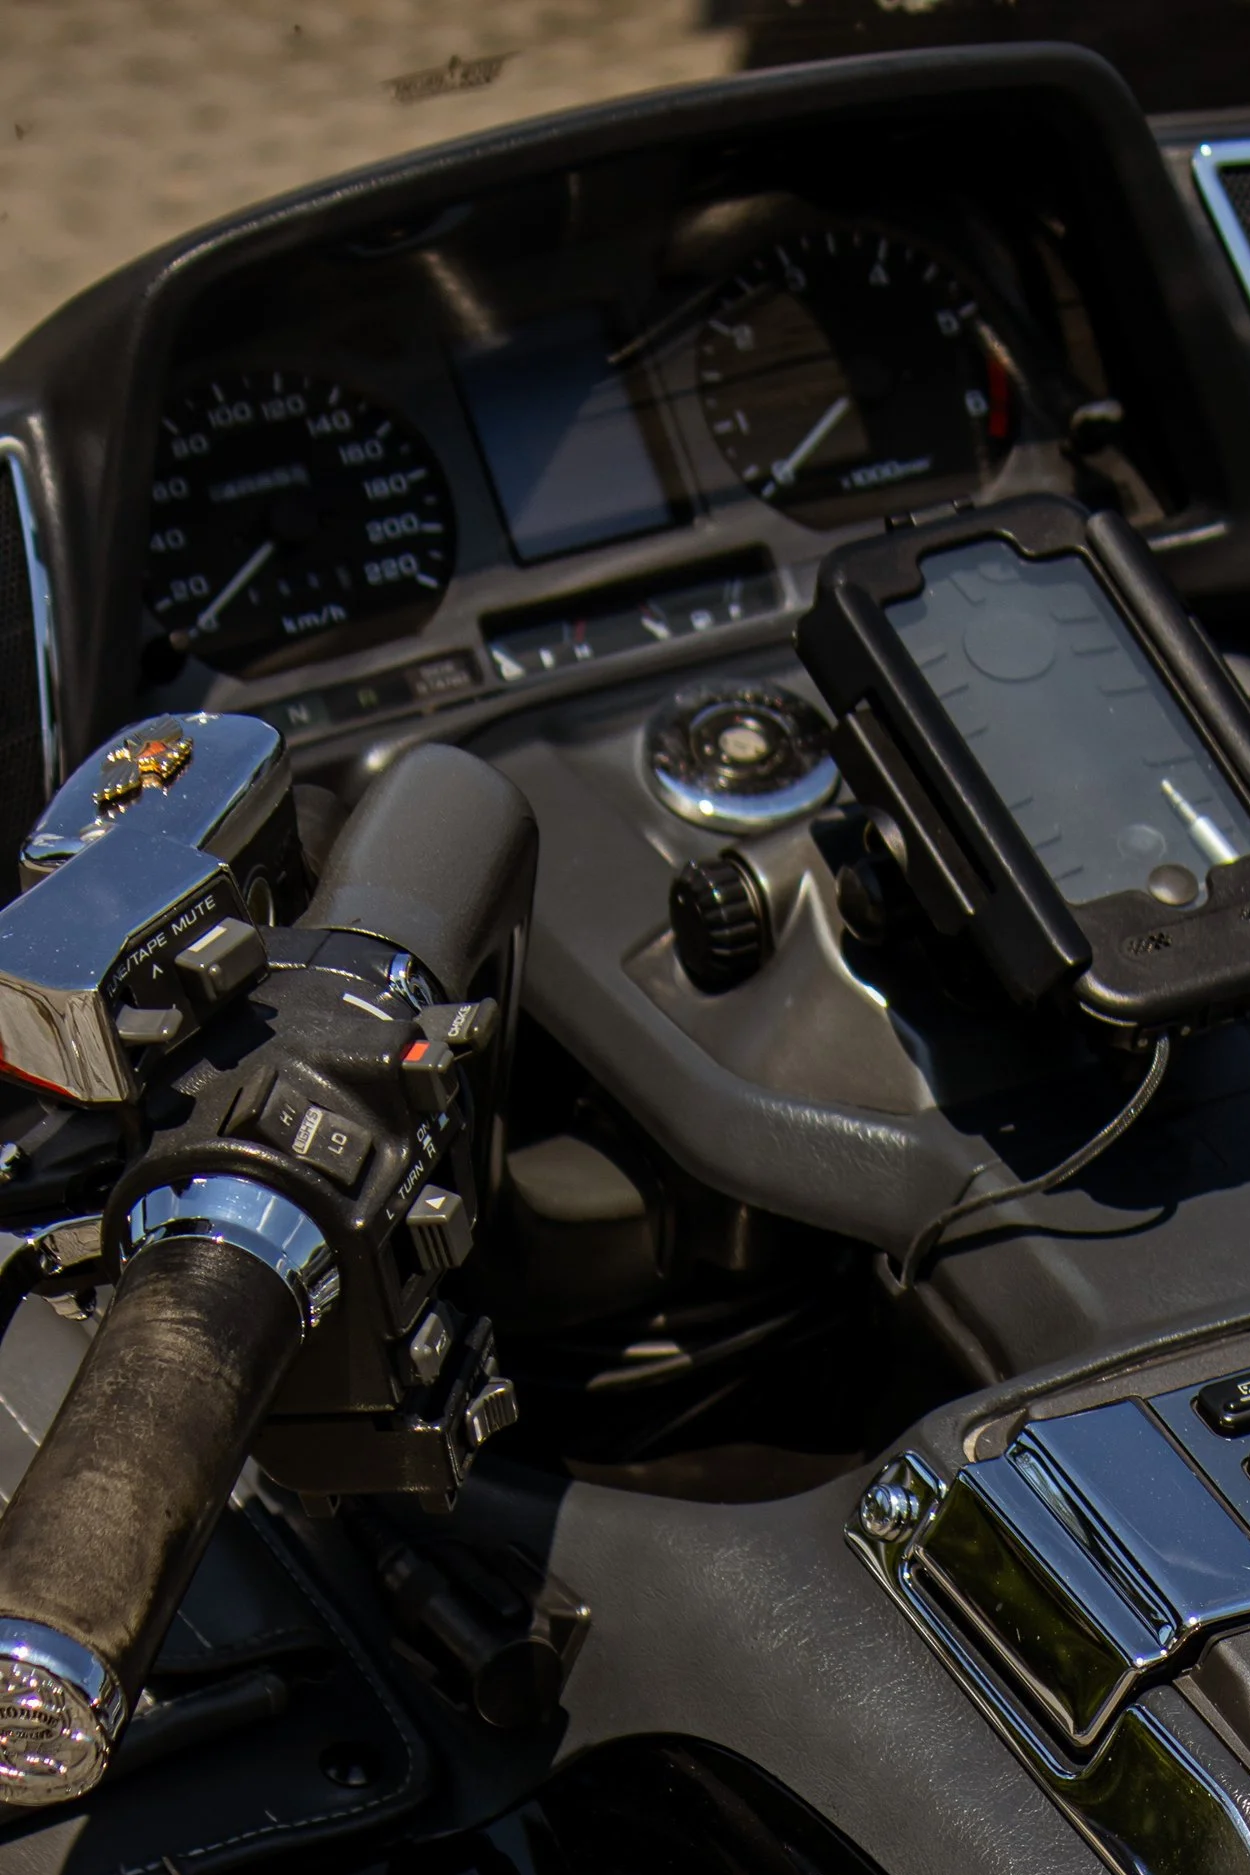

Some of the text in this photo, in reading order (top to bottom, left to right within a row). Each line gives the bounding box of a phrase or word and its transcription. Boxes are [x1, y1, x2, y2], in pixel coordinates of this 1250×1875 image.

[207, 401, 252, 429] 100
[262, 393, 306, 423] 120
[306, 409, 352, 439] 140
[171, 433, 211, 460] 80
[338, 438, 386, 467] 160
[362, 470, 411, 502] 180
[365, 512, 420, 546] 200
[363, 552, 419, 586] 220
[282, 602, 348, 634] km/h
[171, 894, 216, 936] MUTE
[280, 1102, 296, 1127] HI
[327, 1132, 347, 1155] LO
[398, 1160, 425, 1200] TURN
